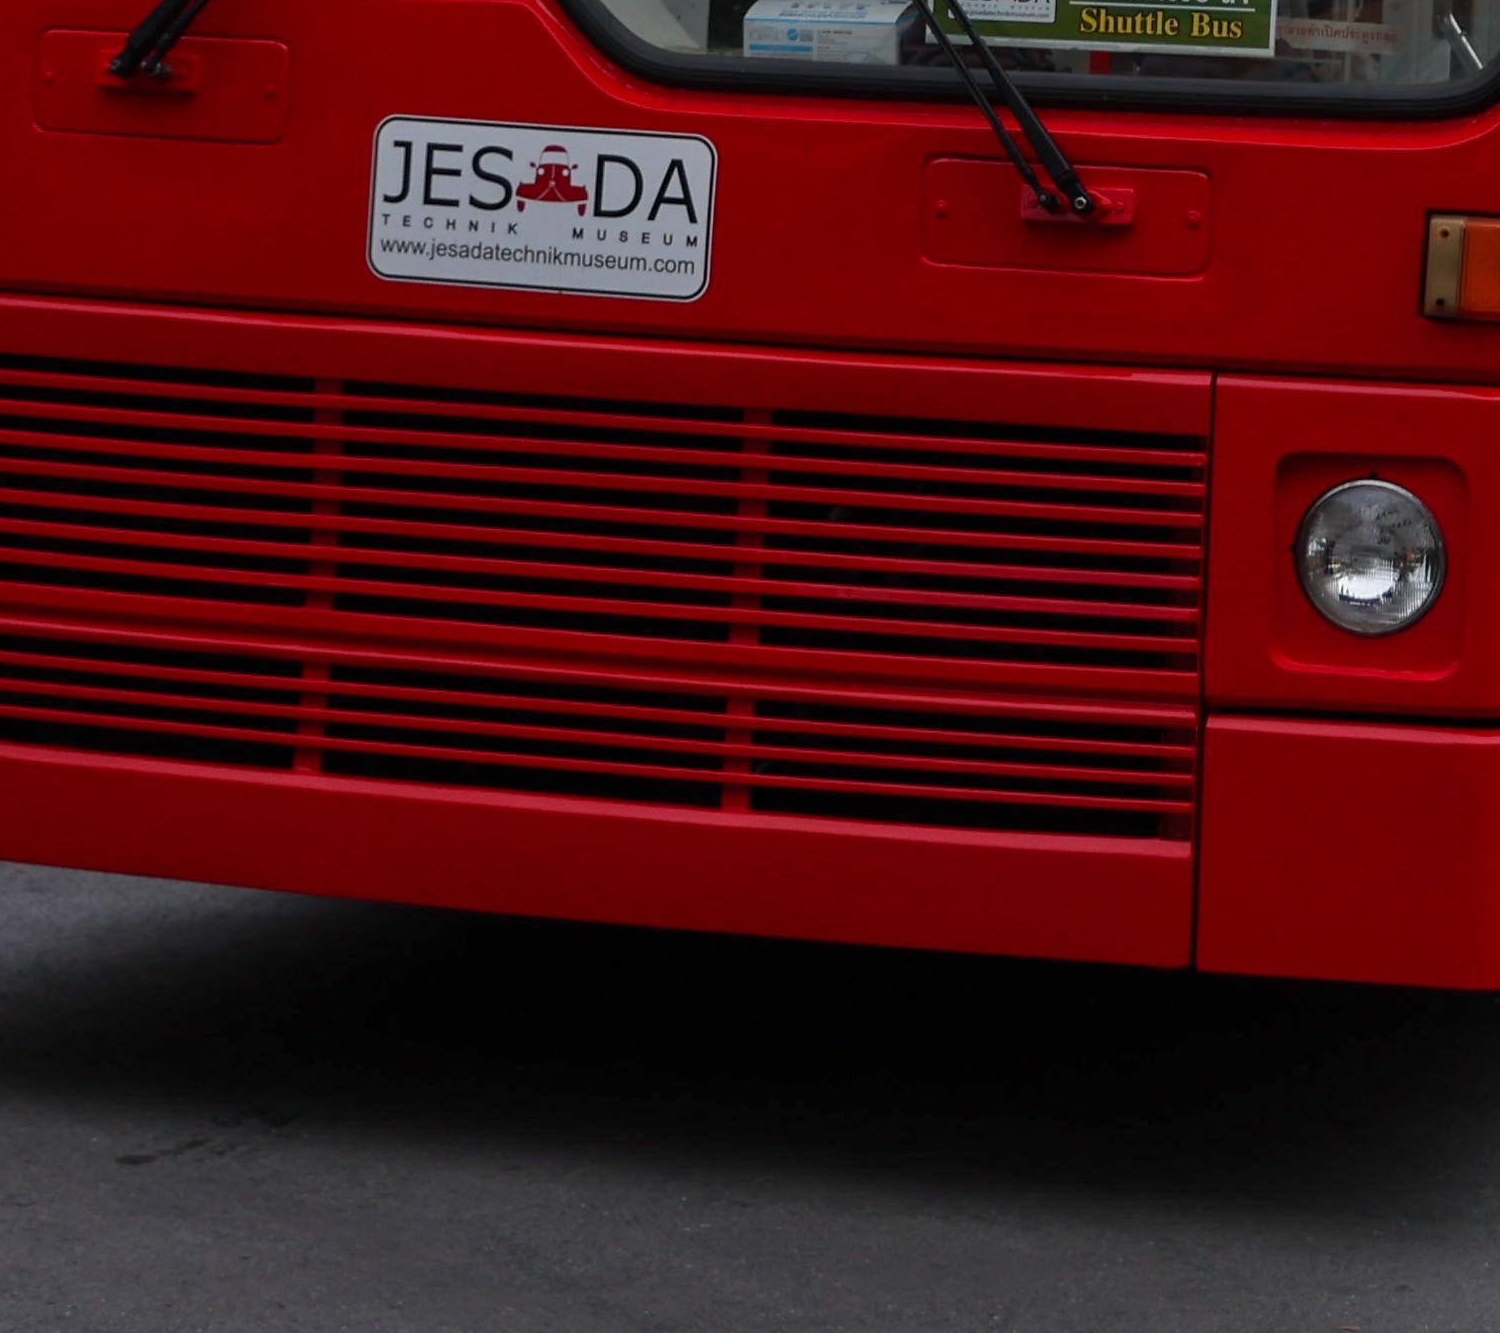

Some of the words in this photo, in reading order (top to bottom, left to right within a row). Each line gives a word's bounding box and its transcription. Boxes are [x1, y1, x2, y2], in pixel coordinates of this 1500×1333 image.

[1079, 7, 1180, 37] Shuttle
[1190, 12, 1244, 40] Bus
[381, 213, 519, 235] TECHNIK
[572, 227, 699, 248] MUSEUM
[380, 237, 696, 275] www.jesadatechnikmuseum.com
